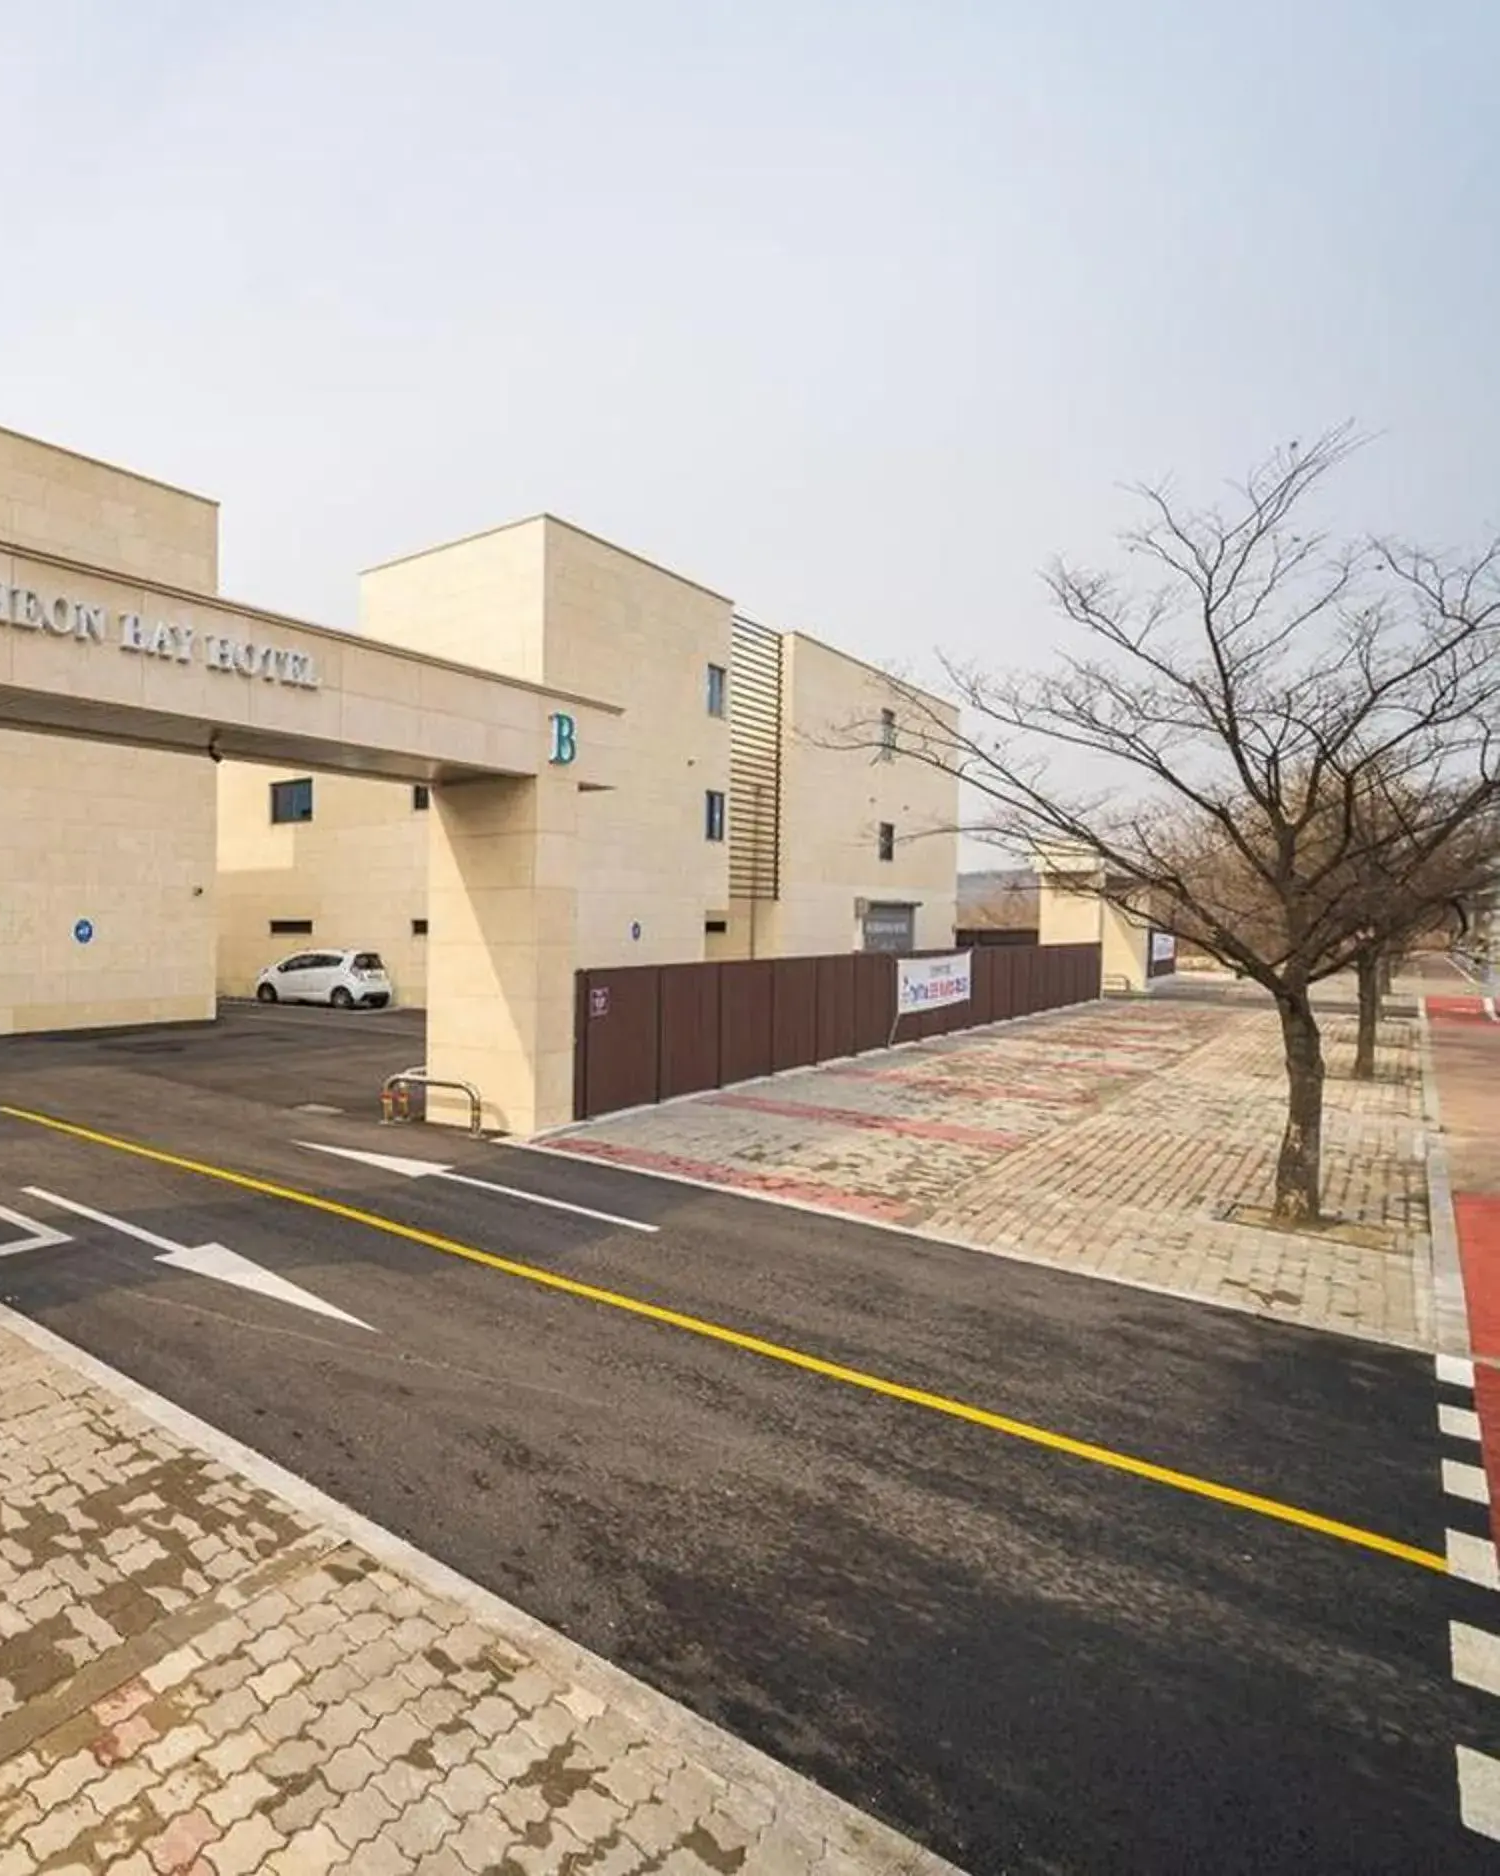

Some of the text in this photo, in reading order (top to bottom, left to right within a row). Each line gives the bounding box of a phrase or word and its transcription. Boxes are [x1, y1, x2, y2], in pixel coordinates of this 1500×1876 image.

[118, 612, 197, 666] BAY
[204, 635, 322, 691] HOTEL
[548, 712, 576, 765] B
